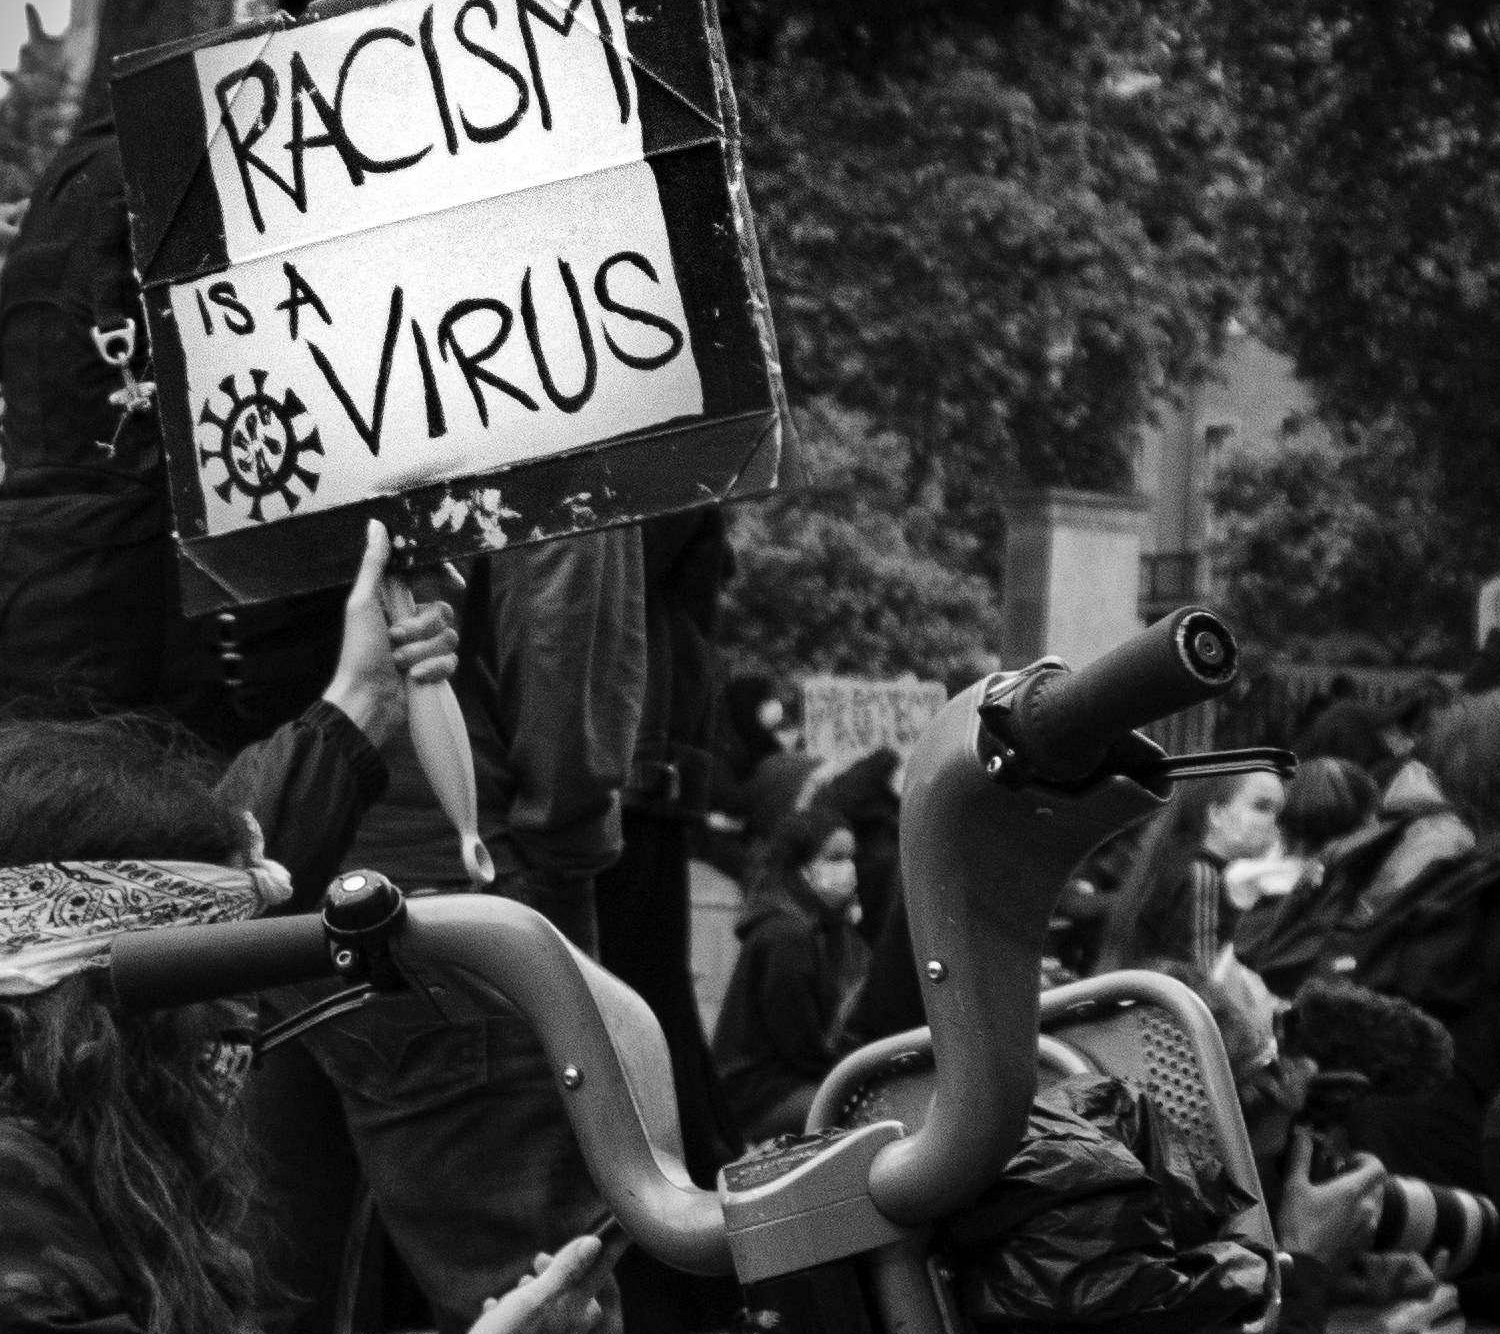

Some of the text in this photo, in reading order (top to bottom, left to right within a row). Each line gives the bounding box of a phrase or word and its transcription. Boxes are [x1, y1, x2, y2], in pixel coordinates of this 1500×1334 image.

[196, 262, 332, 340] IS A
[307, 251, 684, 457] VIRUS
